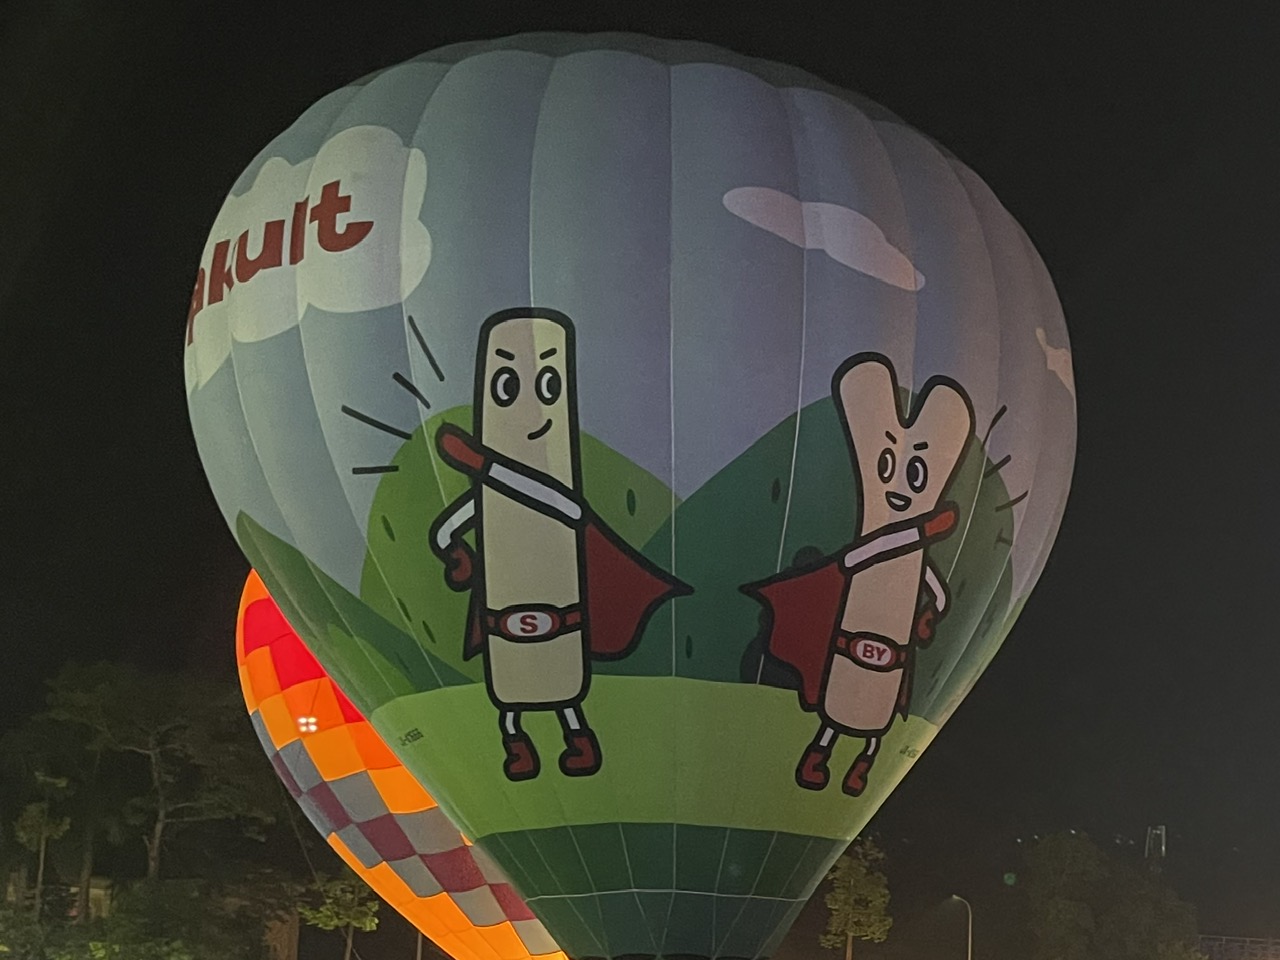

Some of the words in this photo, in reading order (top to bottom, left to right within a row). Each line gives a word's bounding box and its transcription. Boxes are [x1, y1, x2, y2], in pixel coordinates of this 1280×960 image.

[186, 179, 374, 347] akult
[520, 614, 538, 634] S
[862, 643, 887, 661] BY
